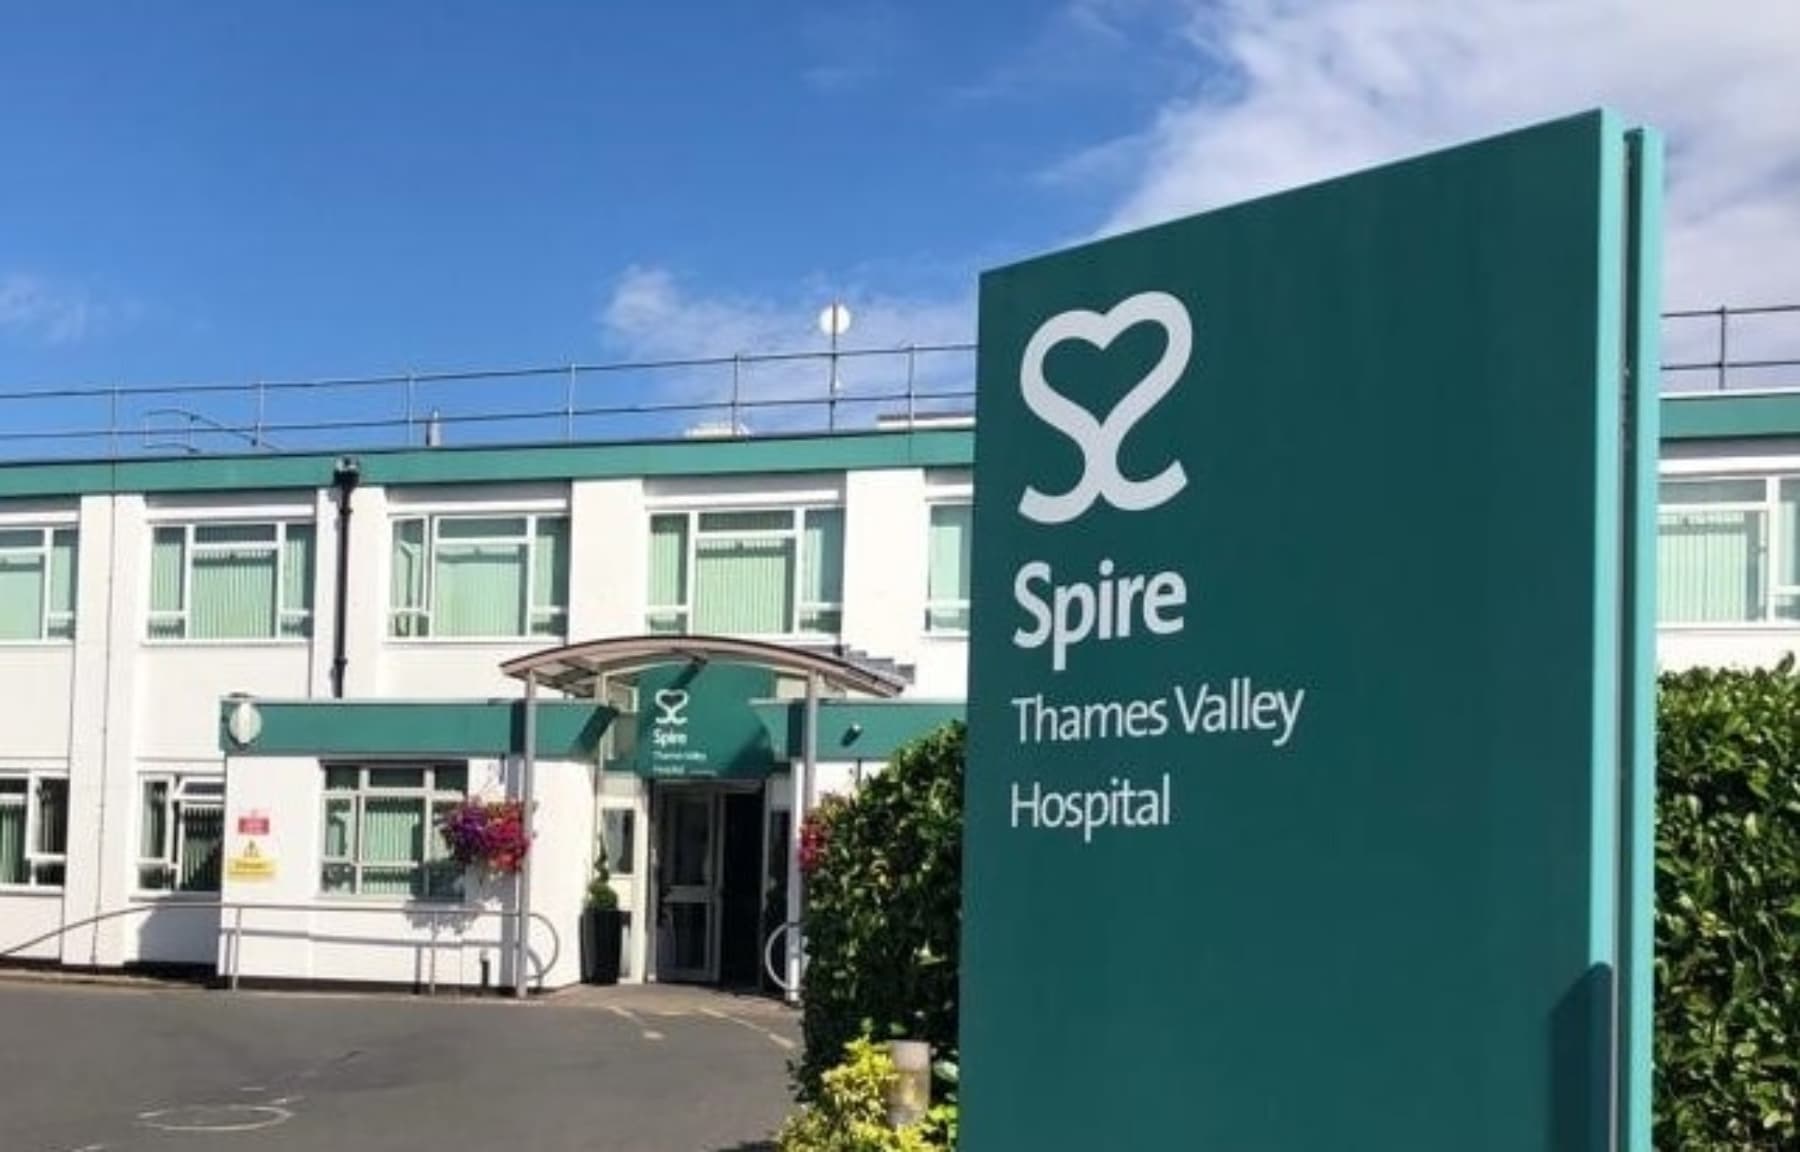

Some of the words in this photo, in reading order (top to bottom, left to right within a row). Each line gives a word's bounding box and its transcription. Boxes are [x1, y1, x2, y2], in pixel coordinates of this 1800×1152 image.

[1013, 558, 1187, 671] Spire
[1011, 693, 1169, 743] Thames
[1174, 677, 1305, 746] Valley
[1011, 772, 1170, 843] Hospital
